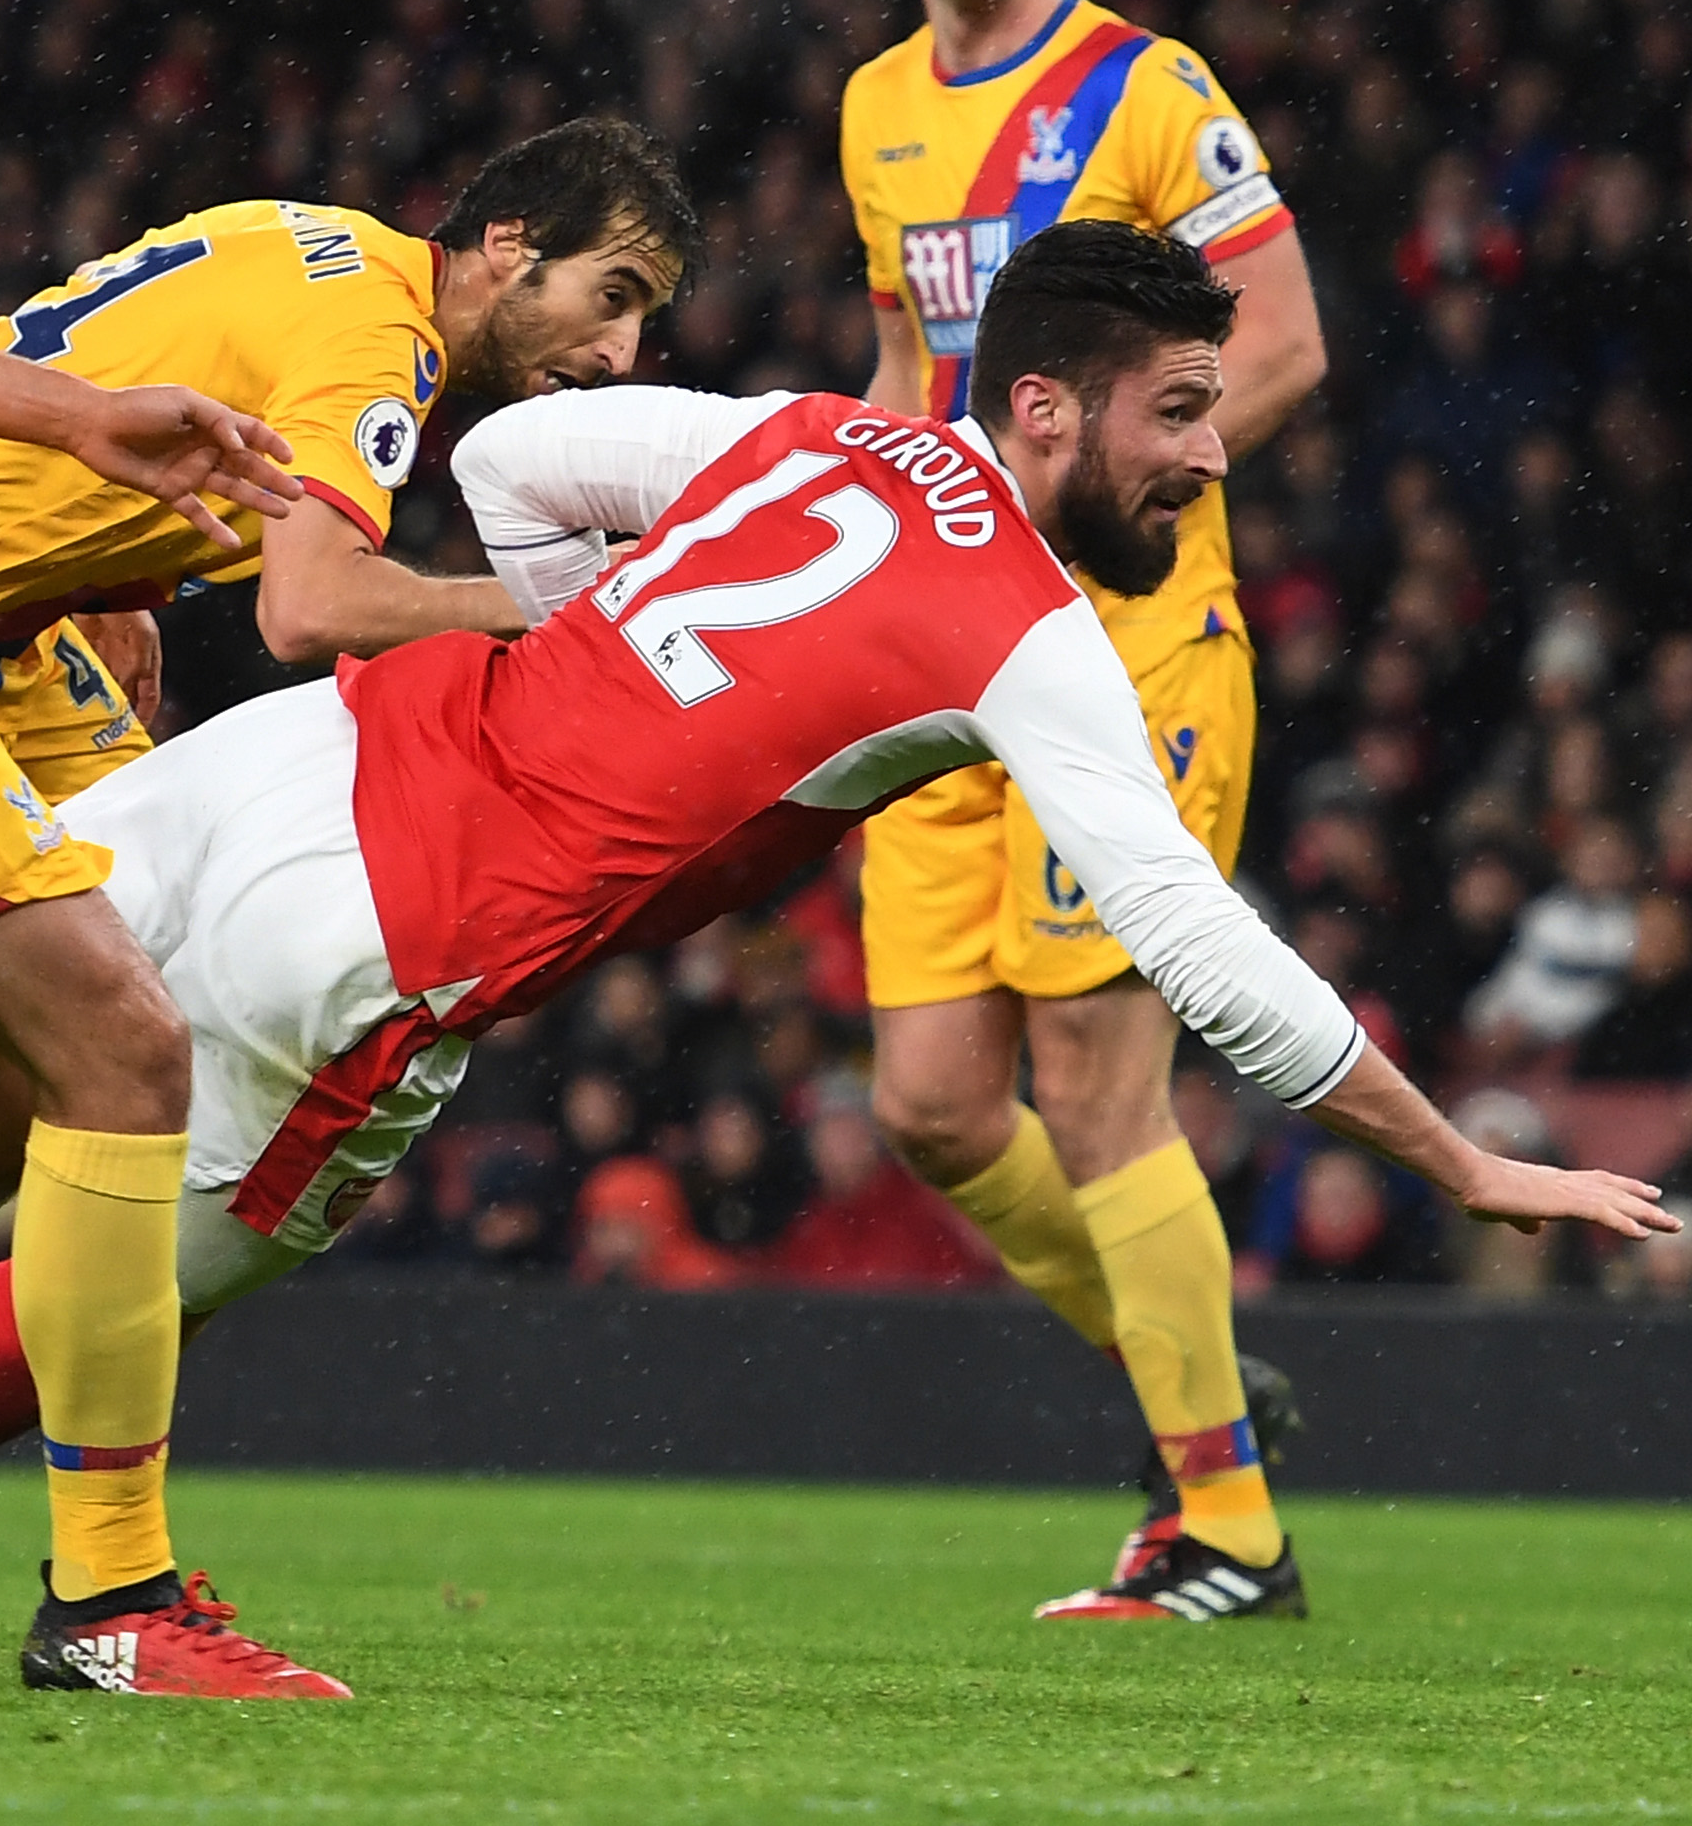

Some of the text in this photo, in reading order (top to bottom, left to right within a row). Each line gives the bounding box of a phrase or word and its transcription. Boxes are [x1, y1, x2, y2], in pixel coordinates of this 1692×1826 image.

[834, 417, 996, 548] GIROUD
[591, 449, 900, 709] 12
[53, 633, 117, 715] 4
